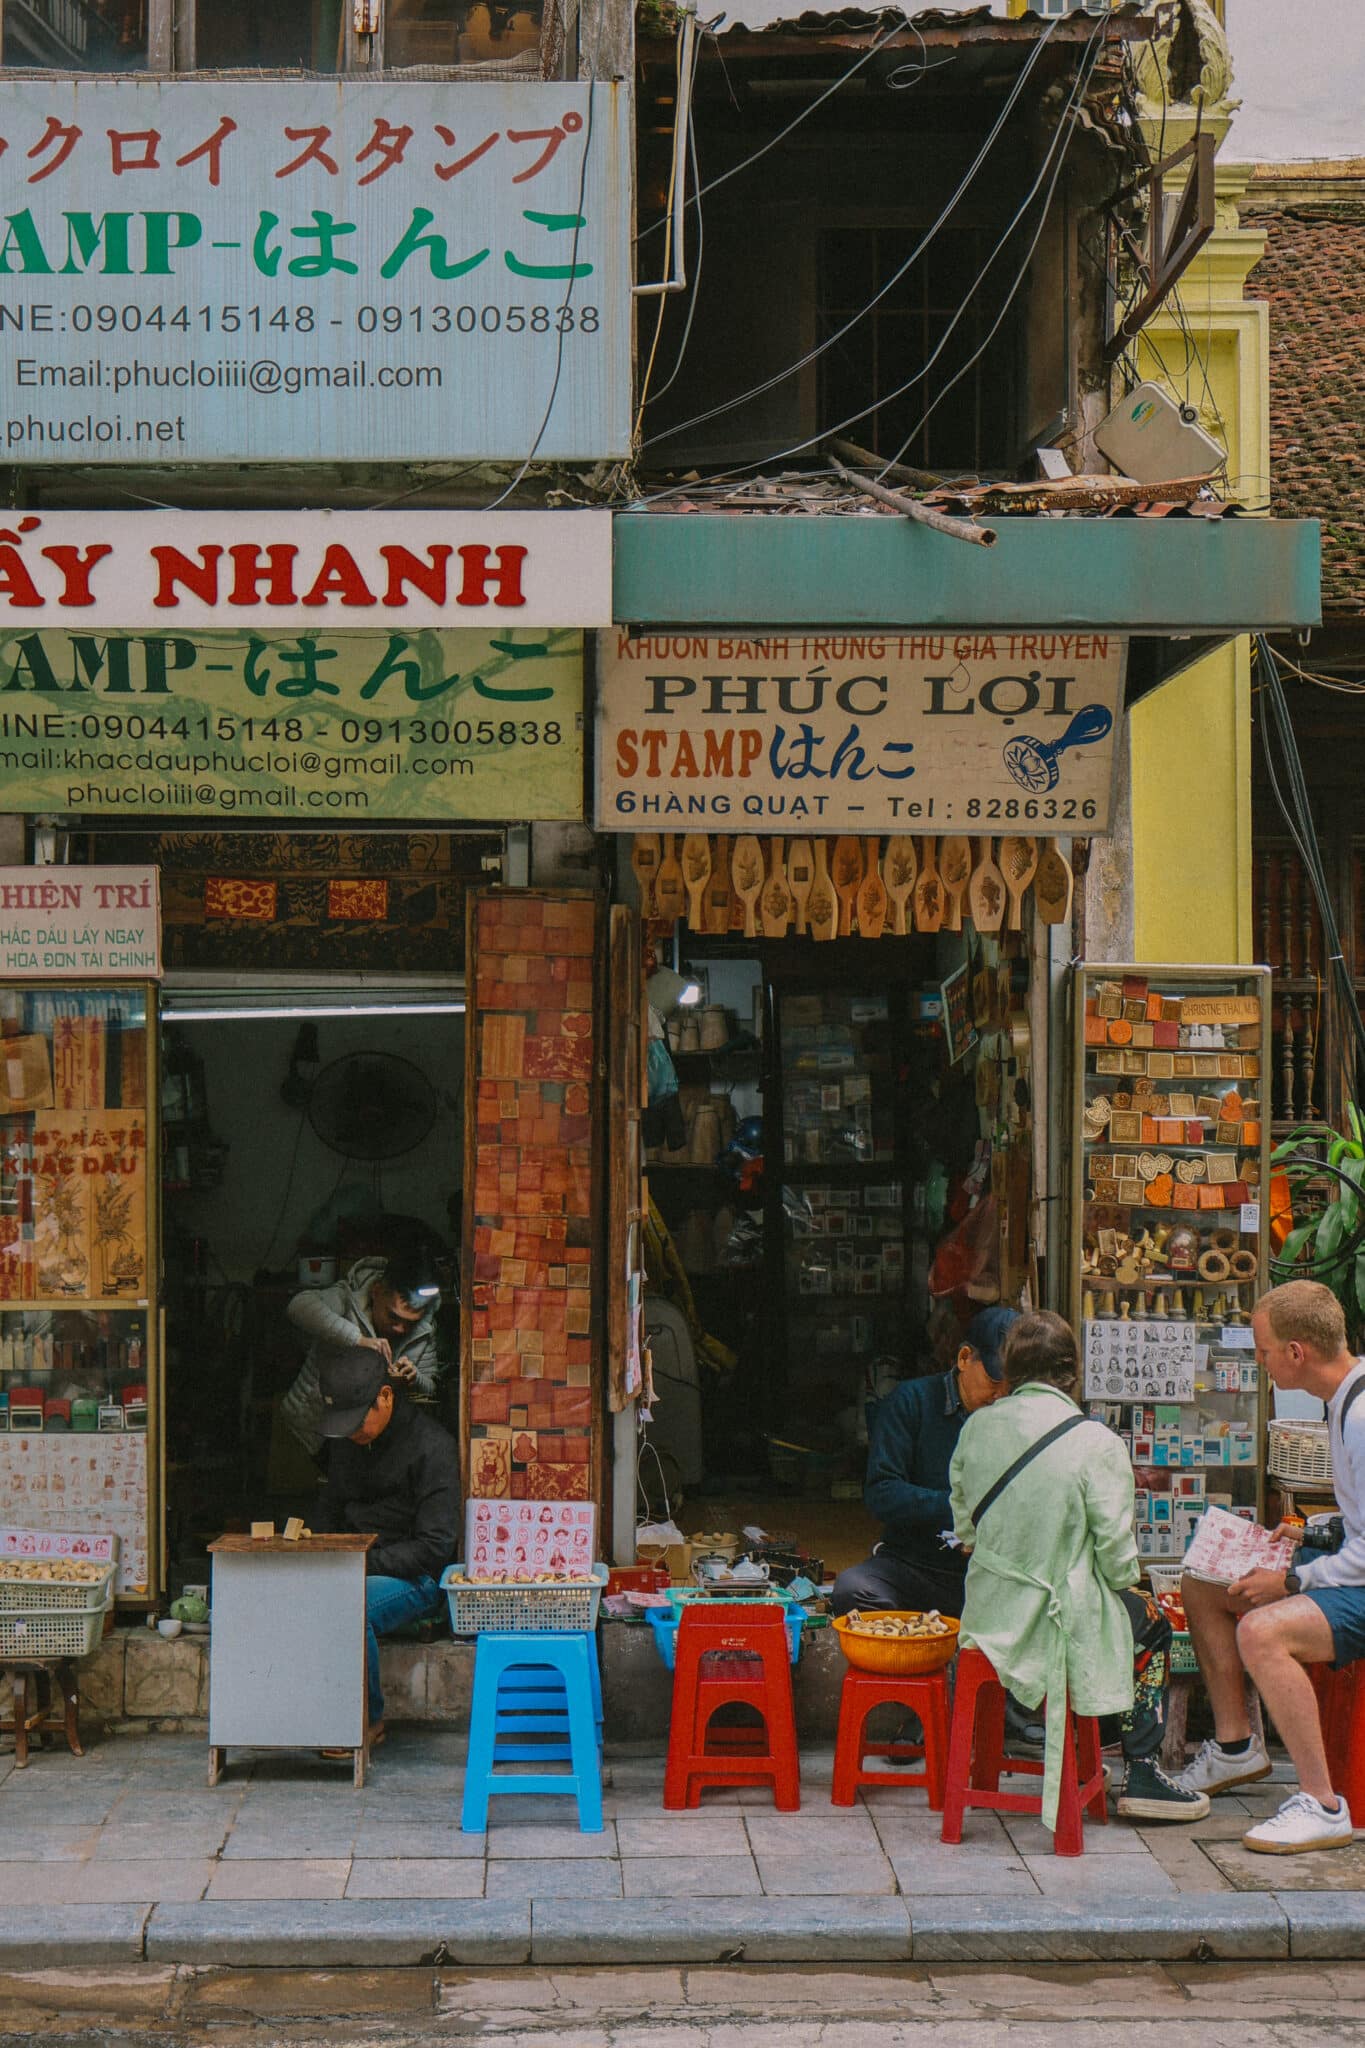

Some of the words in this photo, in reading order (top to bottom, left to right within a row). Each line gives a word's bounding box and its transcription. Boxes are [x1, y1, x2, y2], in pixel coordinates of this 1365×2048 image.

[0, 116, 237, 187] クロイ
[275, 112, 583, 187] スタンプ
[357, 304, 600, 333] 0913005838
[150, 544, 528, 607] NHANH
[954, 635, 997, 660] GIA
[644, 665, 888, 716] PHÚC
[922, 670, 1076, 725] LỢI
[341, 719, 562, 745] 0913005838
[616, 729, 763, 778] STAMP
[66, 783, 369, 810] phucloiiii@gmail.com
[743, 795, 829, 820] QUẠT
[966, 798, 1097, 819] 8286326
[93, 878, 152, 909] TRÍ
[104, 928, 144, 945] NGAY
